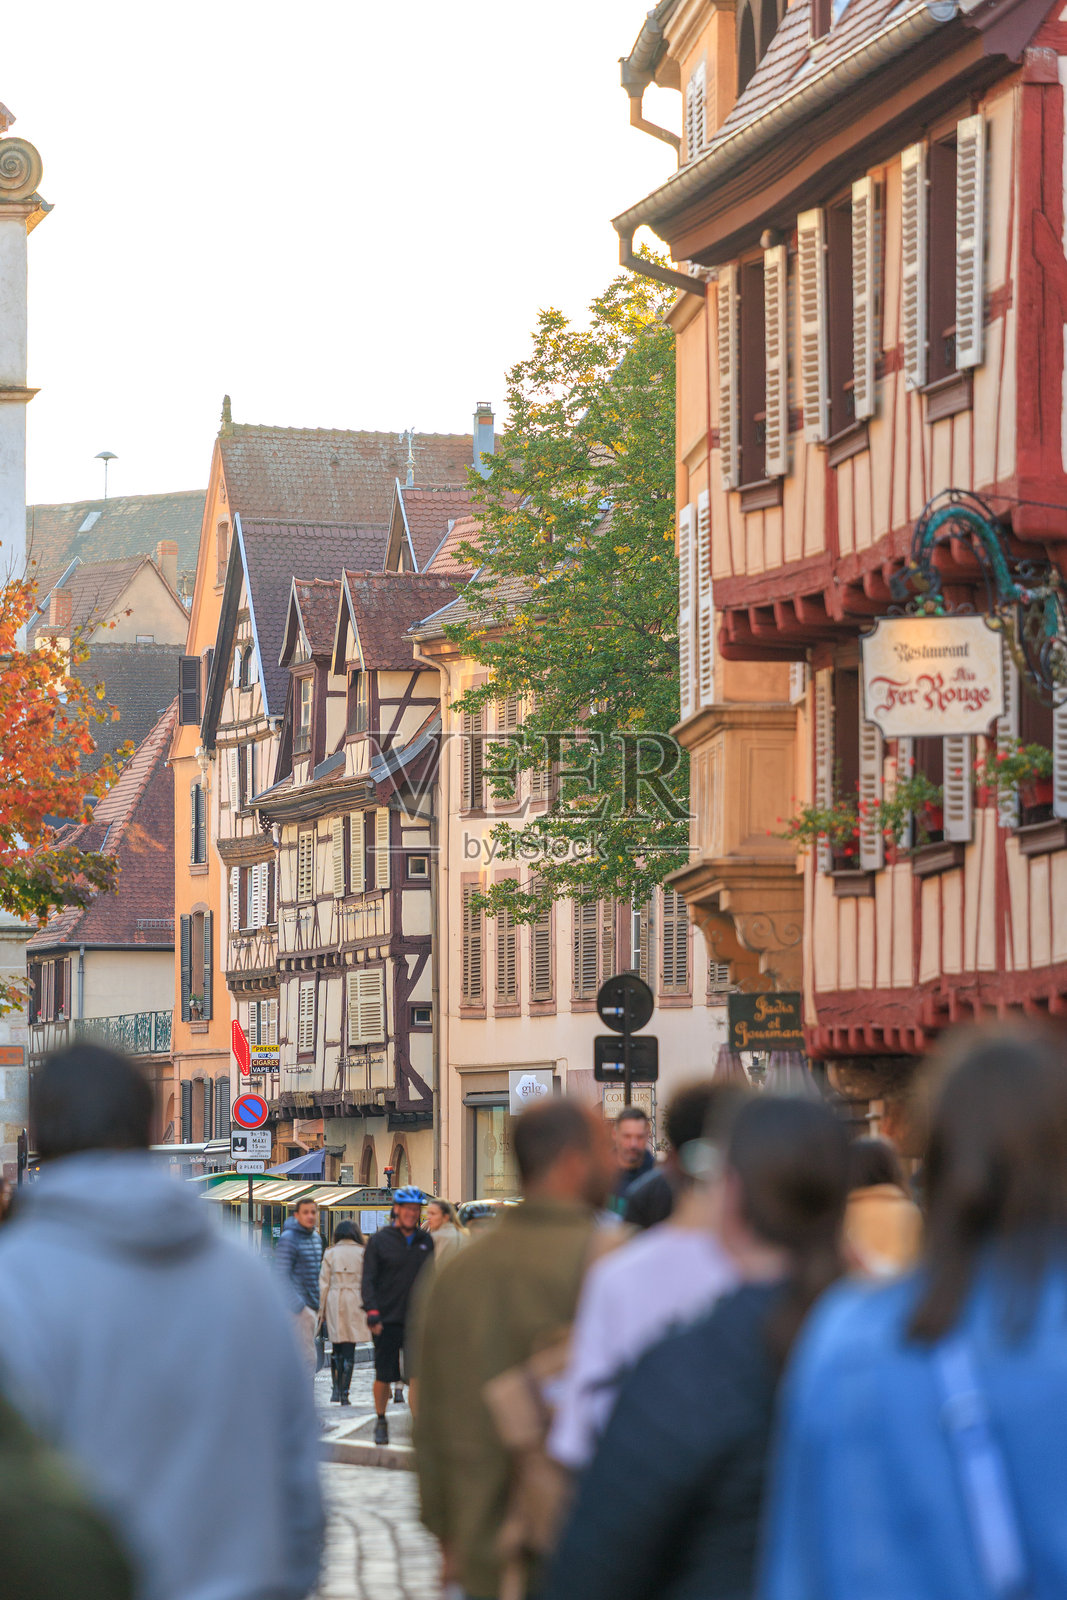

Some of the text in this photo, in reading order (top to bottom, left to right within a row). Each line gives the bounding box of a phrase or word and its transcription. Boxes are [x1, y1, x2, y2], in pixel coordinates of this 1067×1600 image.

[894, 642, 969, 662] Restaurant
[869, 672, 991, 717] Fer Rouge
[734, 1021, 804, 1048] Gourman
[521, 1082, 542, 1097] gilg
